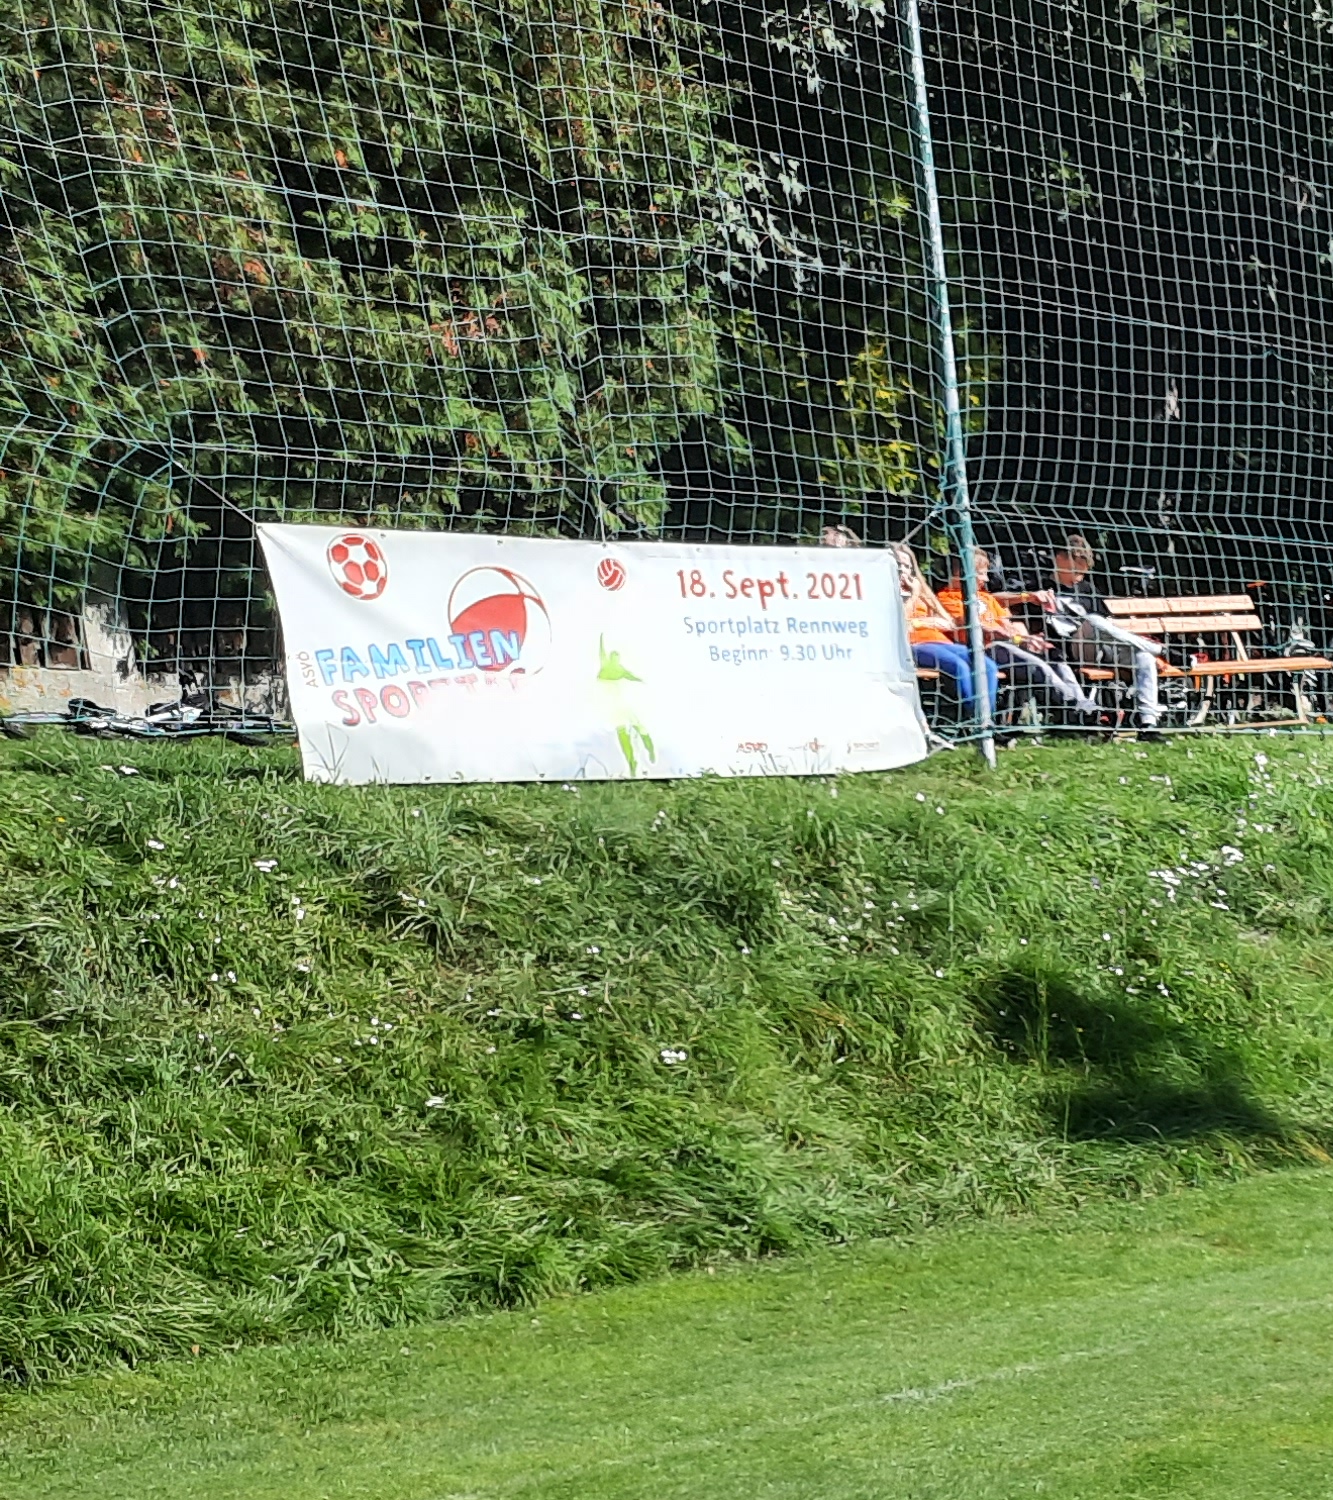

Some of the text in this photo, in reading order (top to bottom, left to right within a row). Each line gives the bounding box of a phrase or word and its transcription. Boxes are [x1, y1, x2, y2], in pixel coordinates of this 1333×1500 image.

[676, 569, 862, 611] 18. Sept. 2021
[683, 616, 869, 638] Sportplatz Rennweg
[297, 650, 319, 688] ASVÖ
[314, 628, 521, 687] FAMILIEN
[779, 643, 817, 661] 9.30
[822, 643, 852, 661] Uhr
